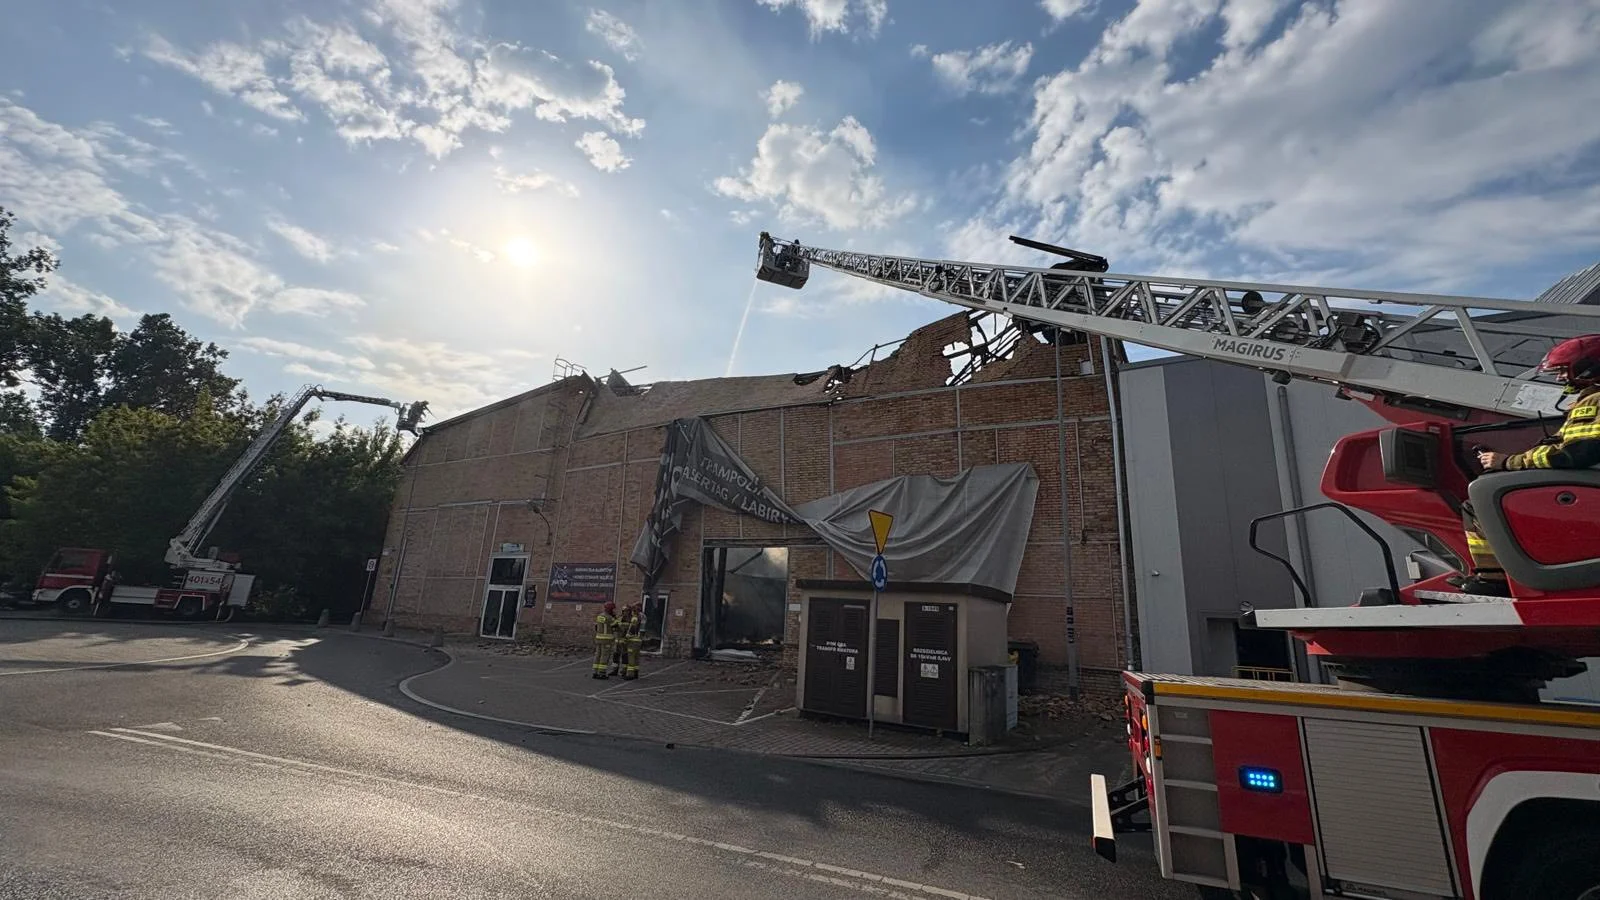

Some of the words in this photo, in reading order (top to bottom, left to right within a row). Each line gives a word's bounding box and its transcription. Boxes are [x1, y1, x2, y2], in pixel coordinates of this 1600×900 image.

[1213, 338, 1286, 361] MAGIRUS
[1574, 407, 1593, 416] PSP
[740, 496, 797, 525] LABIRY
